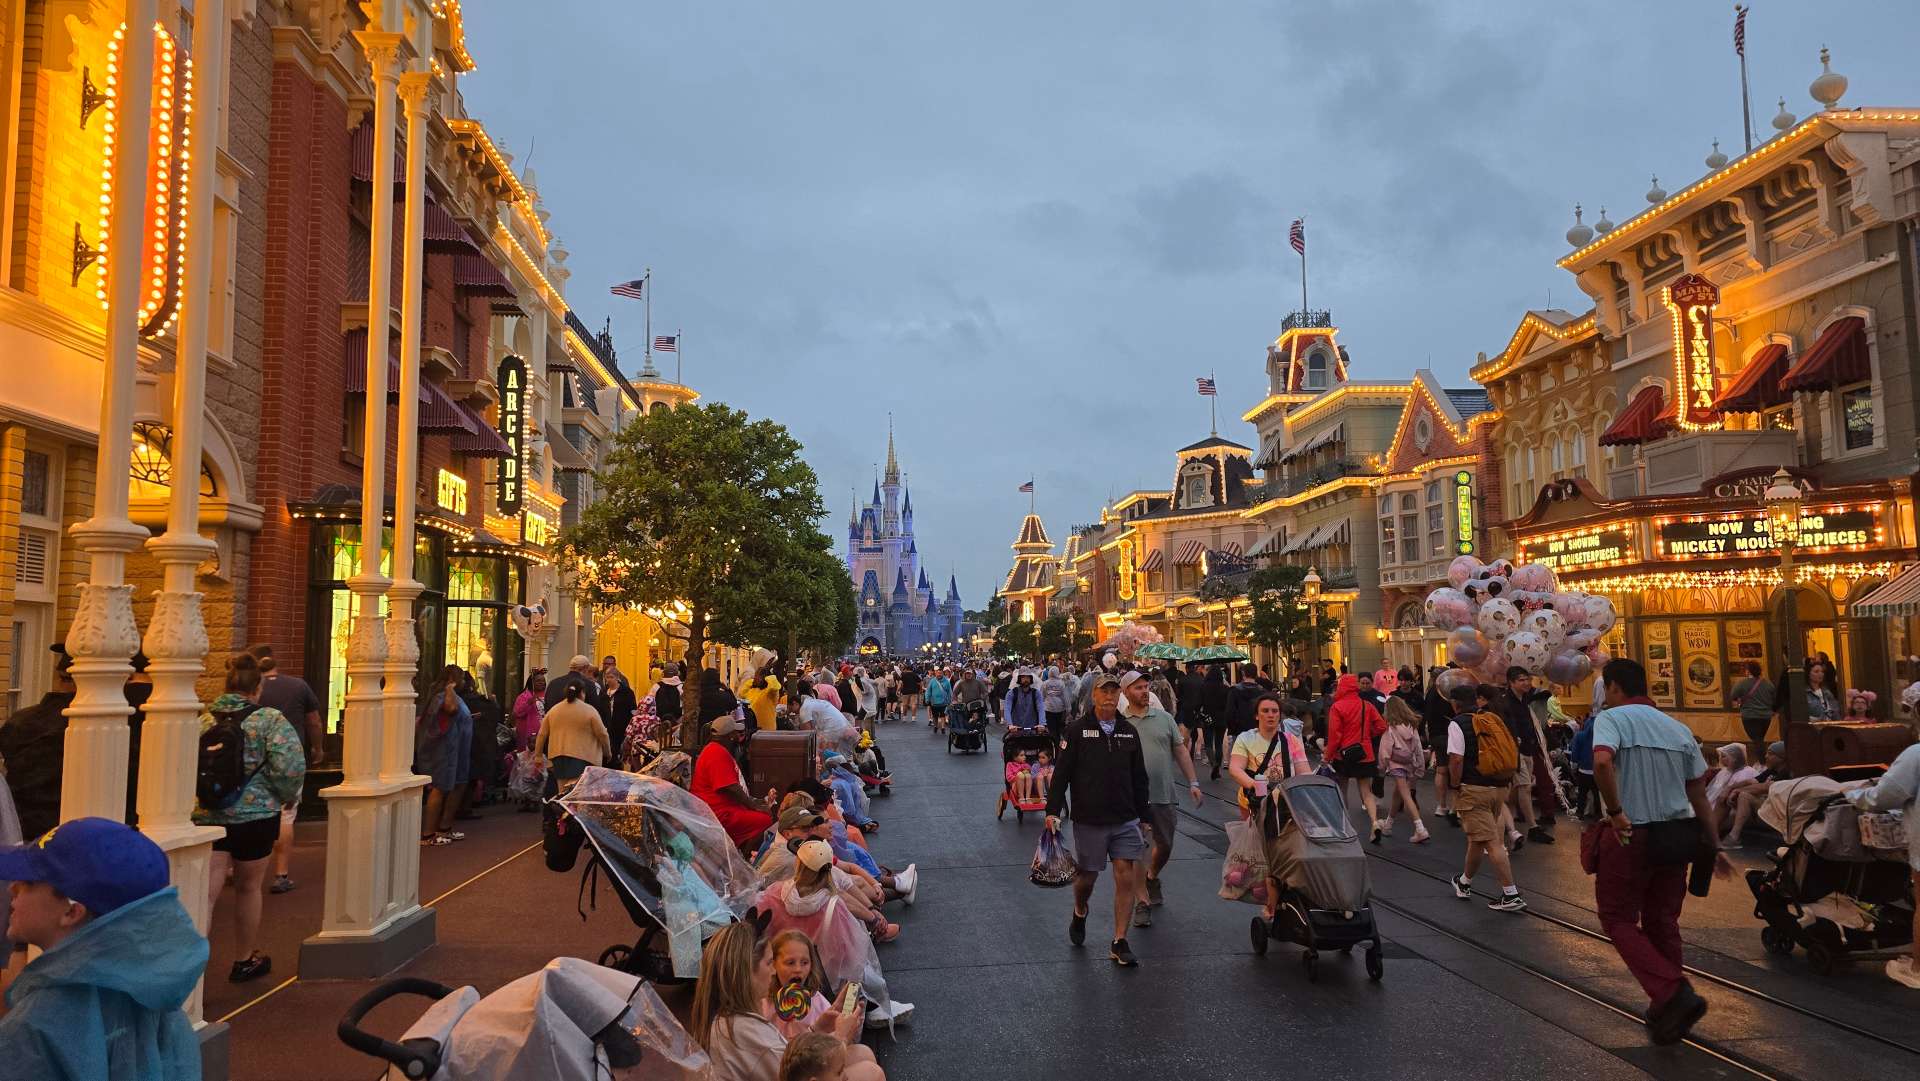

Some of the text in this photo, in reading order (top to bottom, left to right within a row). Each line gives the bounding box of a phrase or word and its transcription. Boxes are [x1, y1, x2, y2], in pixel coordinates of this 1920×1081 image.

[1676, 286, 1711, 298] MAIN
[1688, 304, 1714, 408] CINEMA
[504, 369, 519, 502] ARCADE
[1714, 478, 1814, 498] CINA
[1739, 475, 1772, 485] MAIN
[438, 468, 467, 516] GIFTS
[525, 510, 546, 546] GIFTS
[1708, 521, 1743, 535] NOW
[1549, 535, 1600, 553] NOW SHOWING
[1671, 530, 1867, 553] MICKEY MOUSERPIECES
[1561, 547, 1619, 565] MOUSETERPIECES
